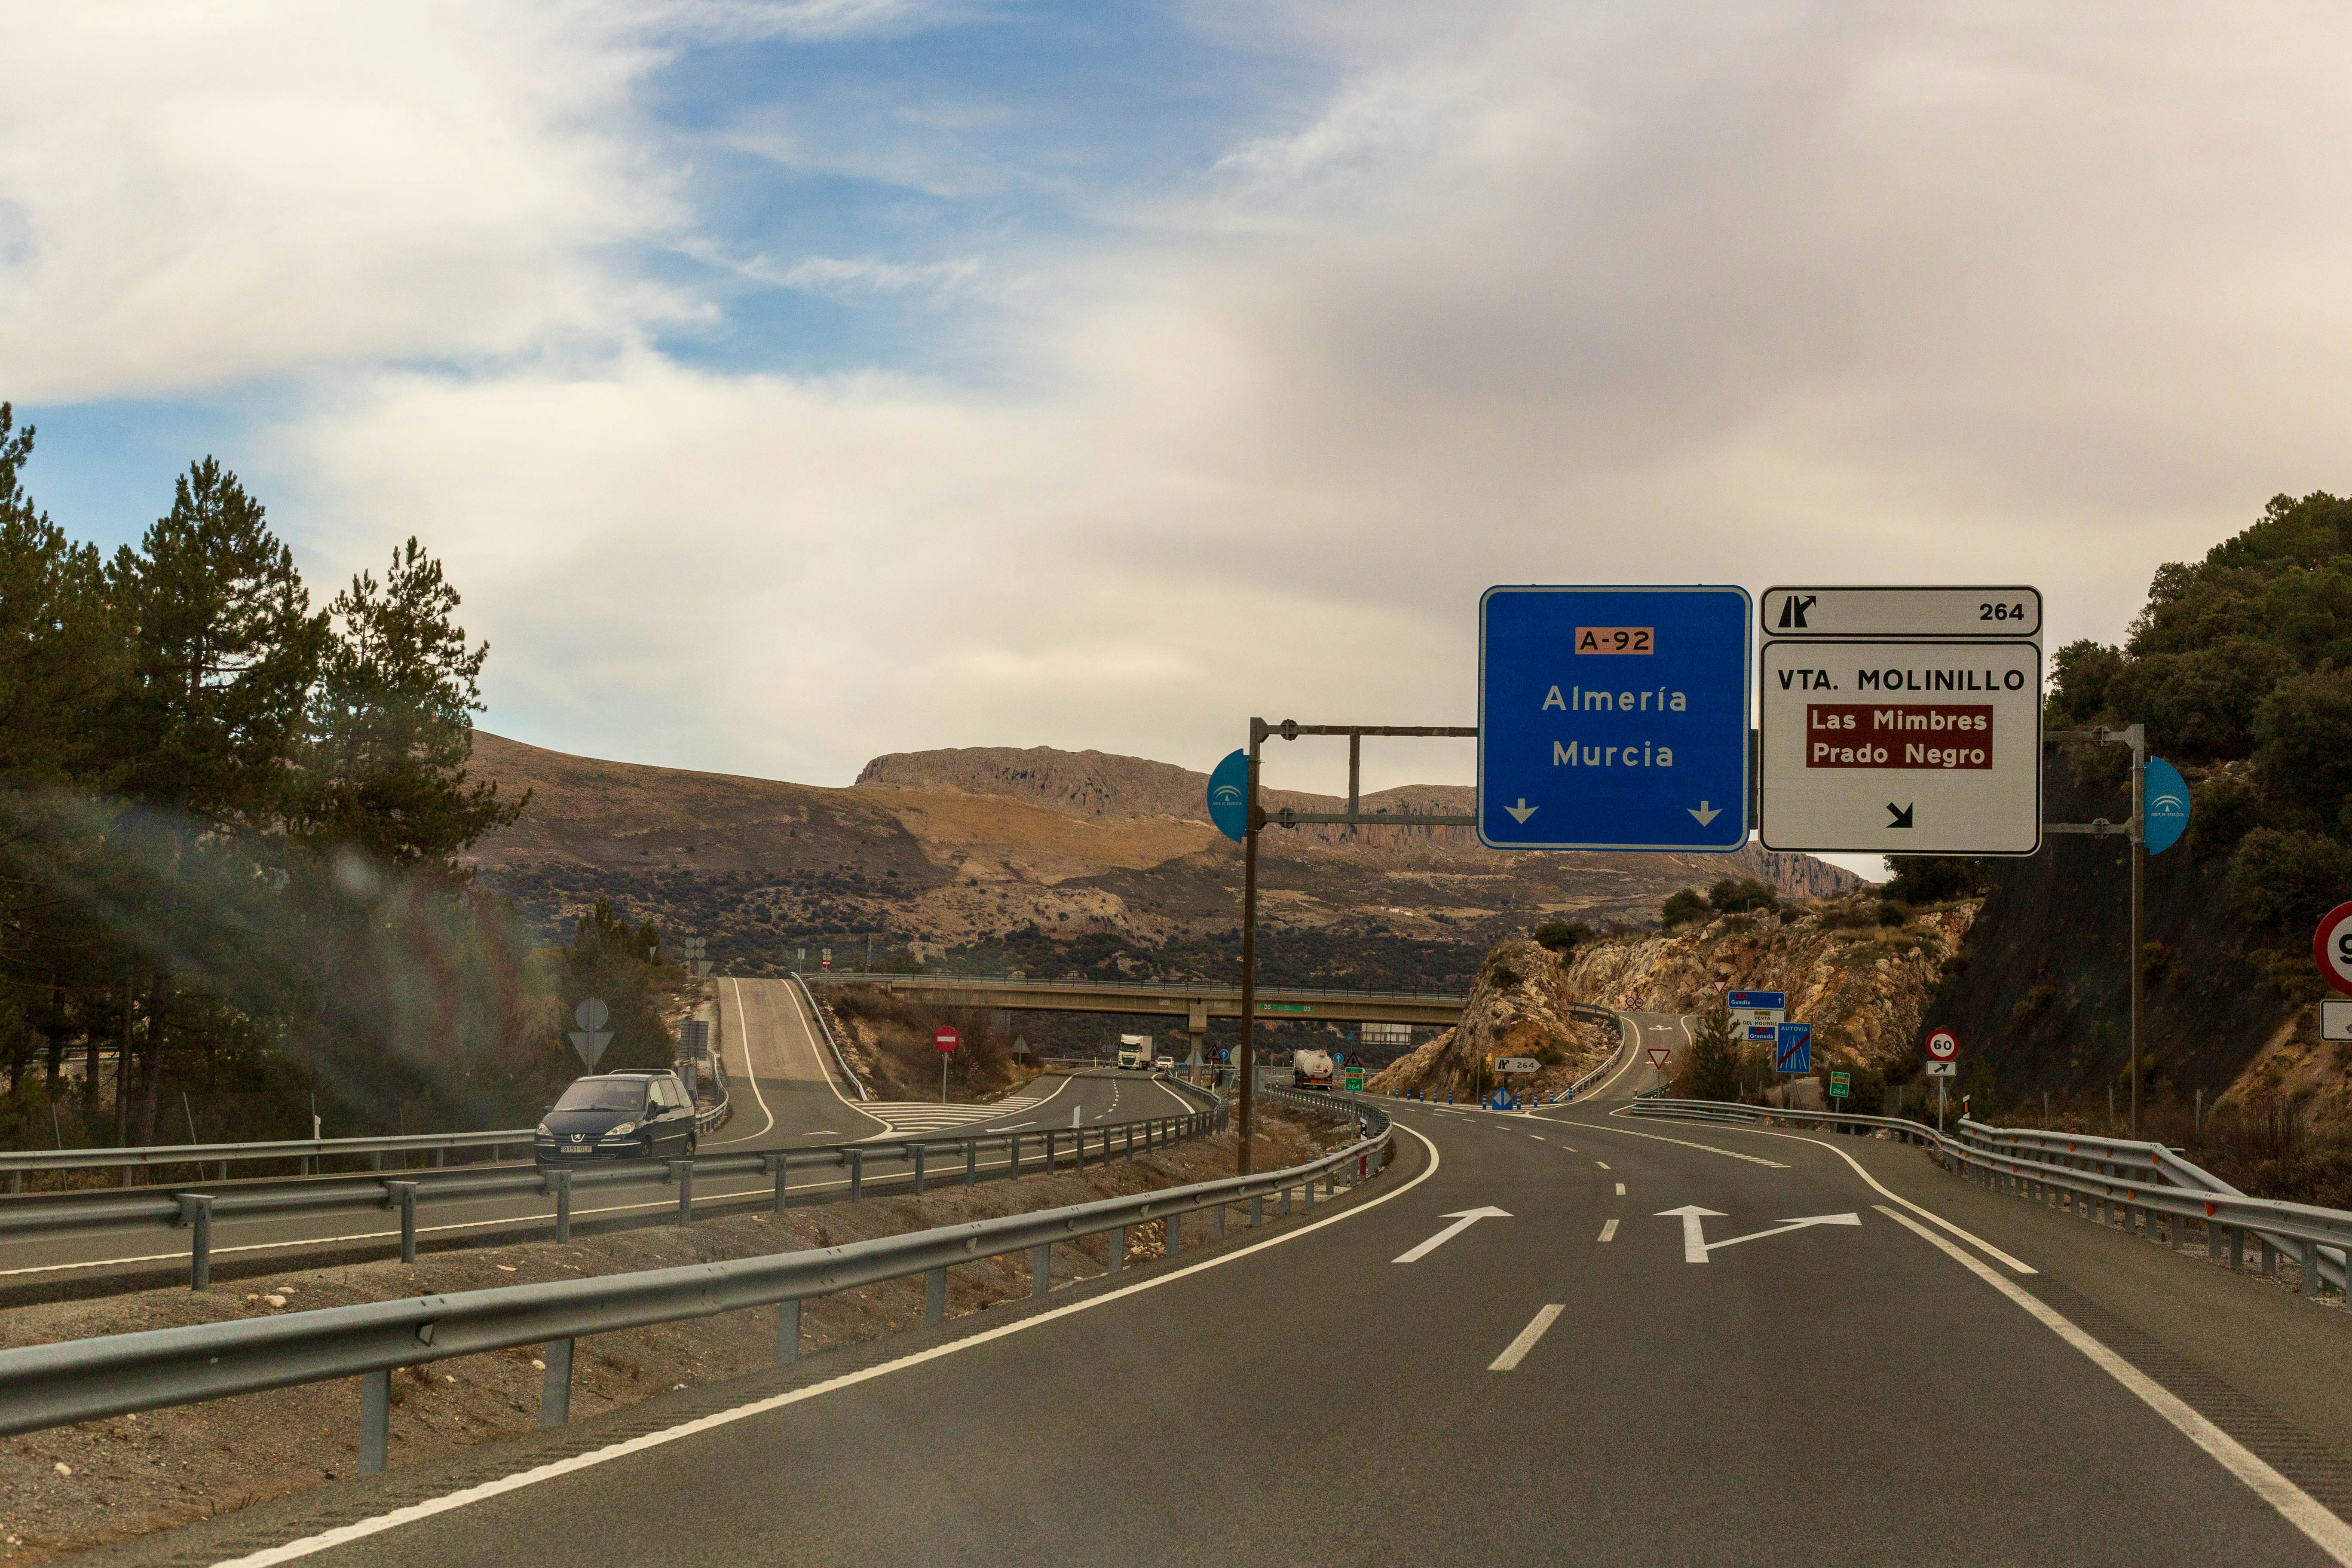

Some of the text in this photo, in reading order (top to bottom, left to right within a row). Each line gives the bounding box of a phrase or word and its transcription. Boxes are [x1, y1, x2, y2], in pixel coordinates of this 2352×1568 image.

[1979, 603, 2024, 620] 264
[1580, 631, 1649, 650] A-92
[1778, 669, 2025, 691] VTA. MOLINILLO
[1542, 685, 1686, 711] Almería
[1813, 710, 1987, 730] Las Mimbres
[1553, 741, 1673, 767] Murcia
[1813, 743, 1985, 768] Prado Negro
[1933, 1039, 1952, 1050] 60
